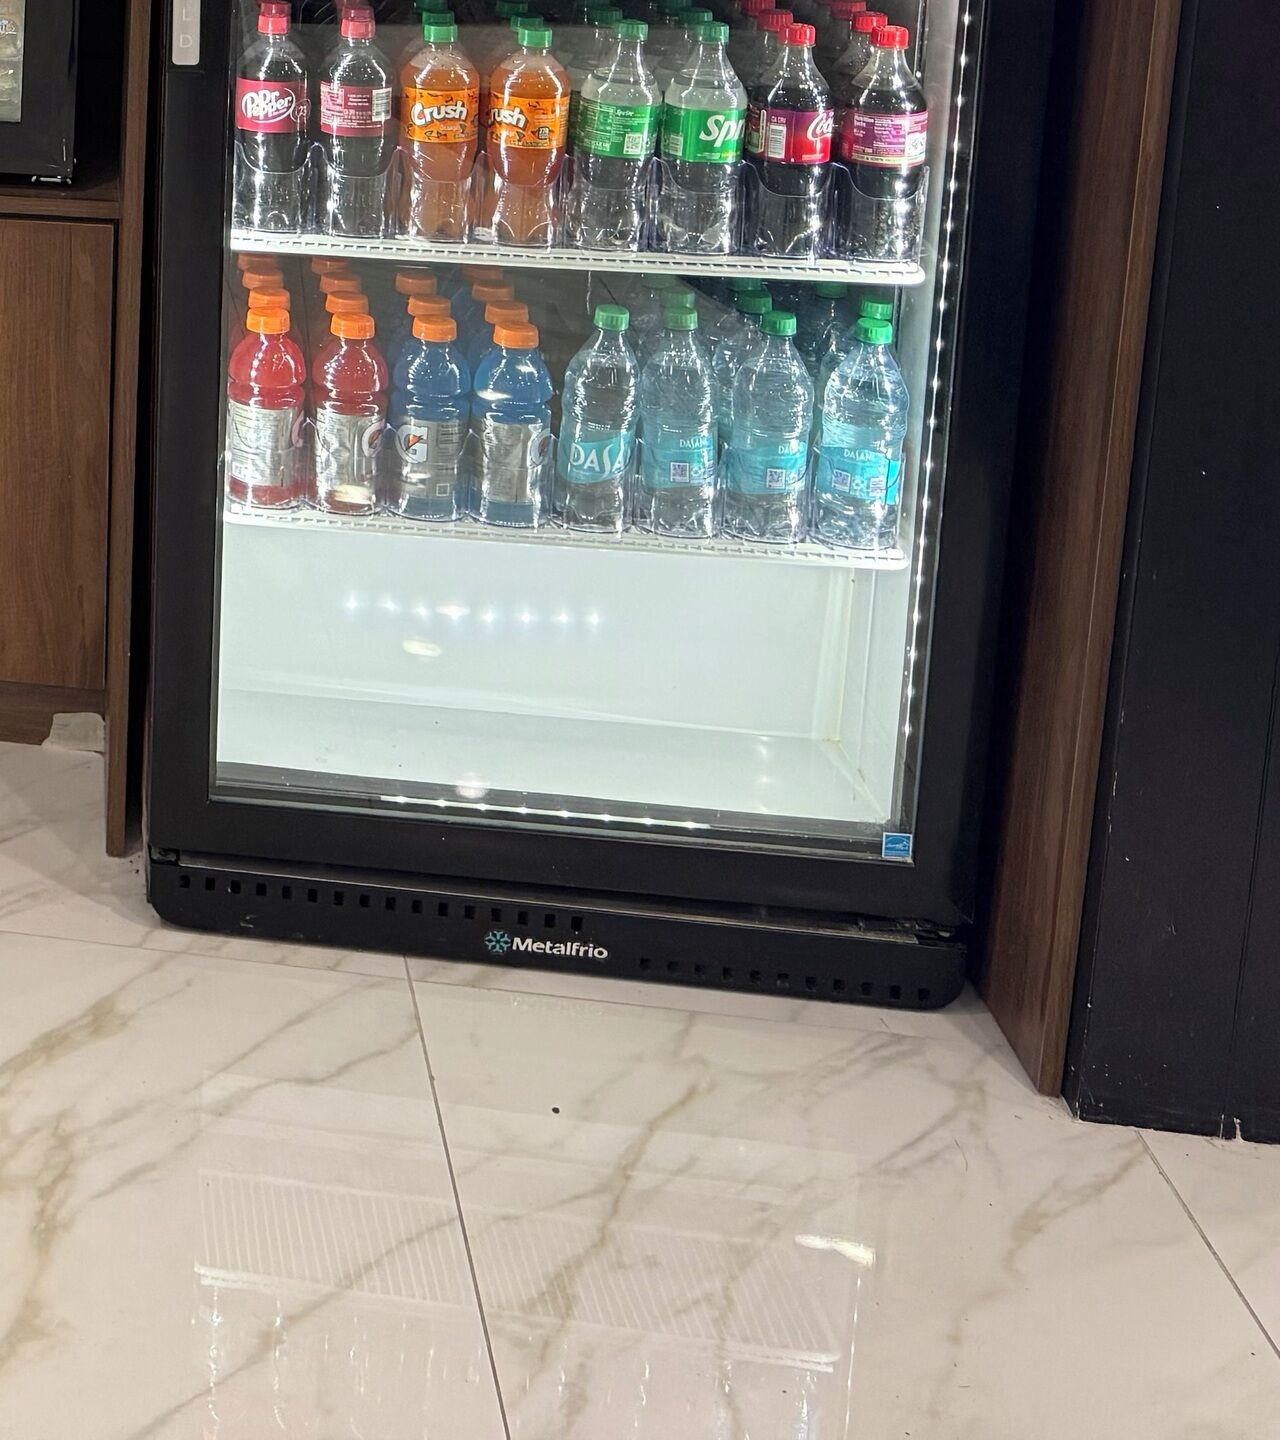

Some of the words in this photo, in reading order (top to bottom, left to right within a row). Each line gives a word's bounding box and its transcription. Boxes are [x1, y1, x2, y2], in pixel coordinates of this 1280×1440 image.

[242, 91, 292, 120] Pepper
[411, 101, 468, 126] Crush
[490, 107, 528, 130] rush
[570, 437, 630, 480] DASA
[512, 935, 609, 960] Metalfrio
